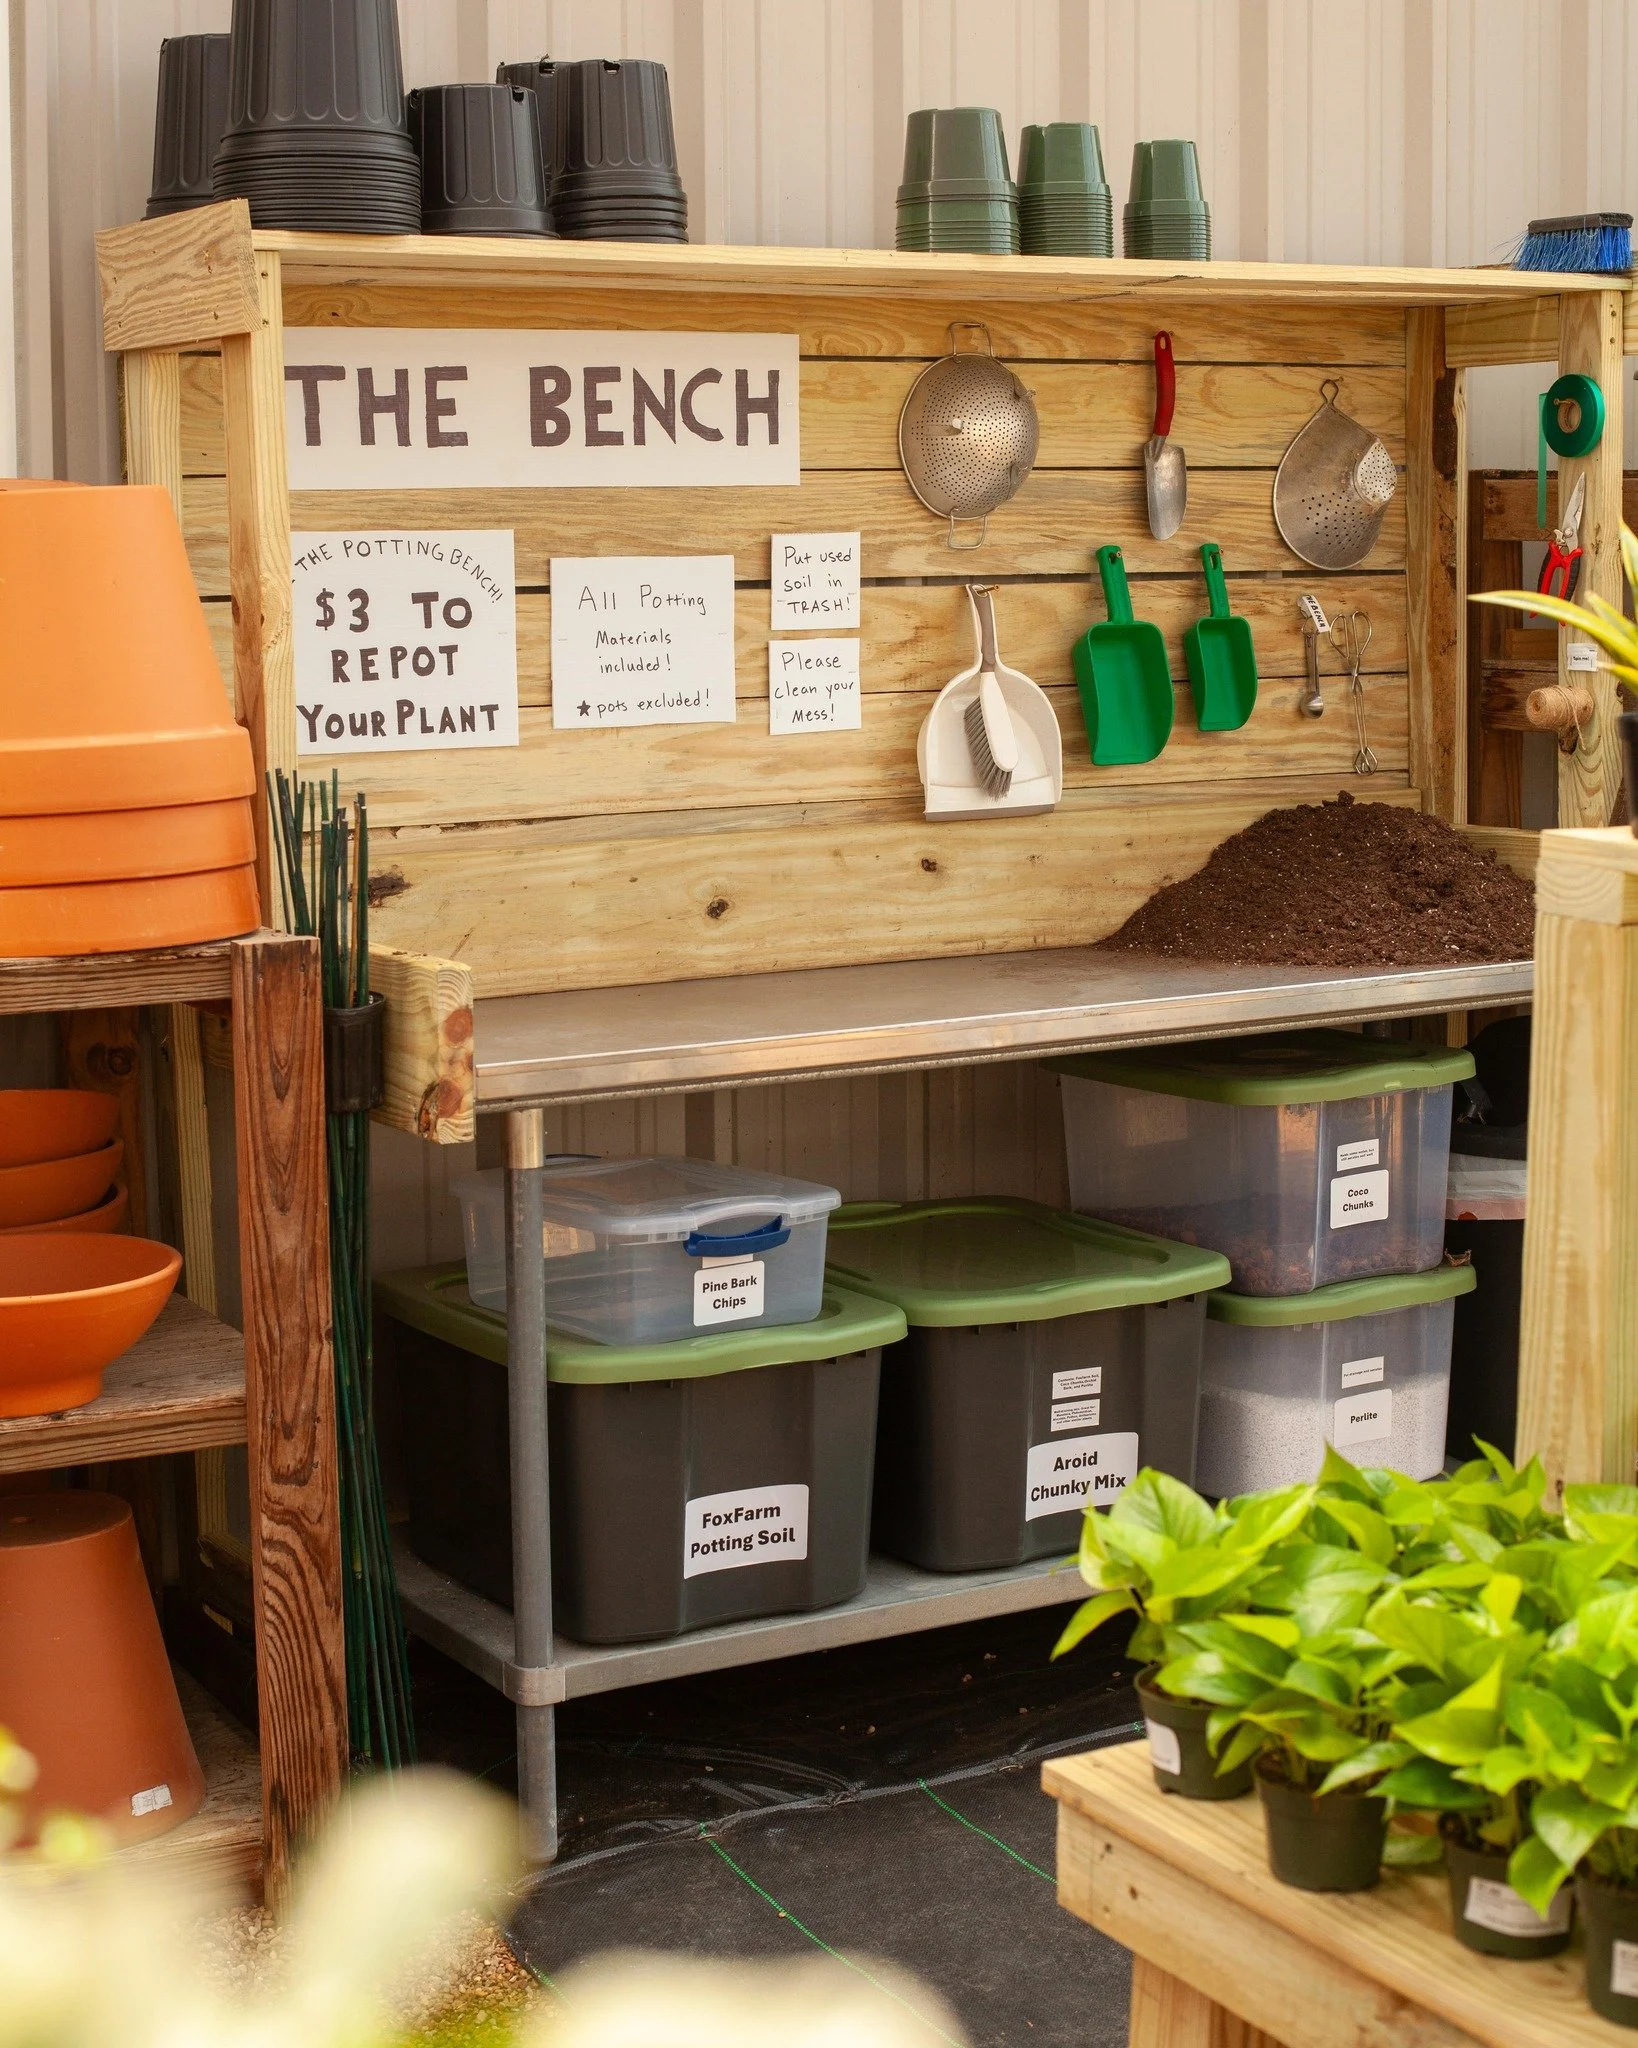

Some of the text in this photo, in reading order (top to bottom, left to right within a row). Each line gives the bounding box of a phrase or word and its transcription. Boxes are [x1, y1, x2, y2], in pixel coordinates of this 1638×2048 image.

[284, 365, 780, 449] THE BENCH
[784, 546, 852, 567] Put used
[295, 539, 503, 603] THE POTTING BENCH!
[784, 573, 842, 592] soil in
[578, 584, 706, 615] All Potting
[787, 596, 850, 614] TRASH!
[316, 588, 473, 633] $3 TO
[595, 628, 672, 648] Materials
[331, 644, 458, 683] REPOT
[782, 651, 841, 671] Please
[774, 681, 854, 699] clean your
[597, 688, 709, 718] pots excluded!
[792, 703, 834, 723] Mess!
[396, 699, 499, 735] PLANT
[1347, 1188, 1369, 1198] Coco
[1342, 1200, 1374, 1212] Chunks
[702, 1275, 757, 1293] Pine Bark
[713, 1297, 746, 1309] Chips
[1350, 1412, 1378, 1424] Perlite
[1053, 1451, 1098, 1472] Aroid
[1030, 1473, 1126, 1502] Chunky Mix
[702, 1505, 781, 1529] FoxFarm
[690, 1527, 796, 1558] Potting Soil
